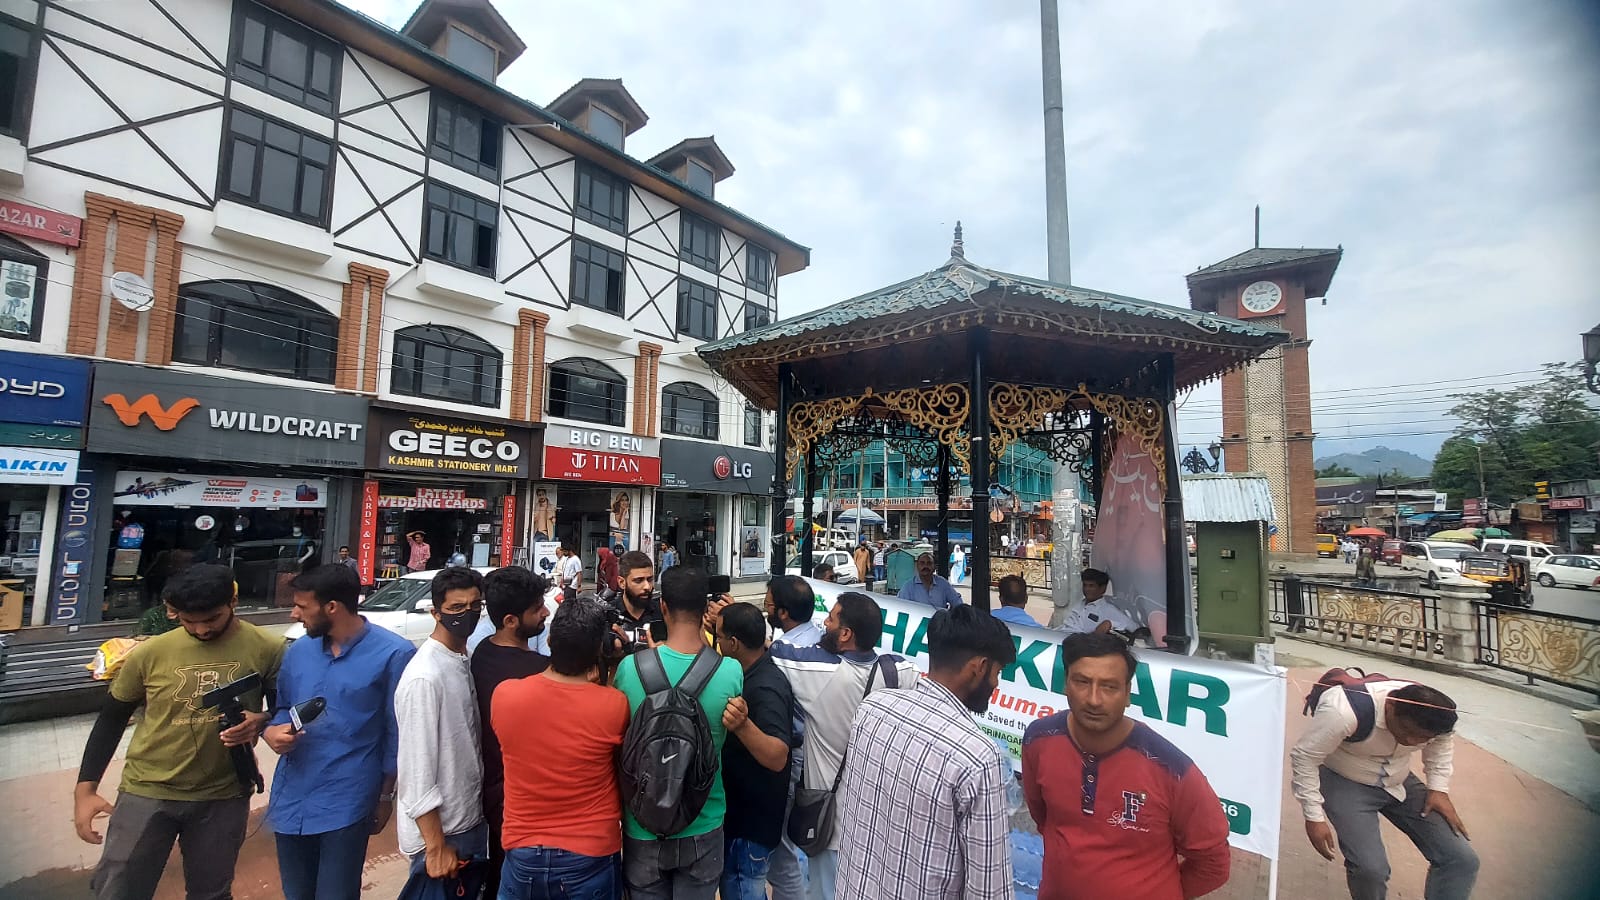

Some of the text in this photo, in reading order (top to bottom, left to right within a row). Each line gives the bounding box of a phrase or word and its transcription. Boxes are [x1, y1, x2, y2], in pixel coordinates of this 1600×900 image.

[209, 408, 362, 441] WILDCRAFT
[388, 429, 520, 461] GEECO
[570, 430, 643, 452] BIG BEN
[388, 455, 519, 474] KASHMIR STATIONERY MART
[592, 454, 640, 473] TITAN
[733, 461, 752, 478] LG
[378, 495, 485, 510] WEDDING CARDS
[417, 487, 465, 500] LATEST
[361, 486, 374, 583] CARDS & GIFTS
[987, 711, 1015, 728] Saved
